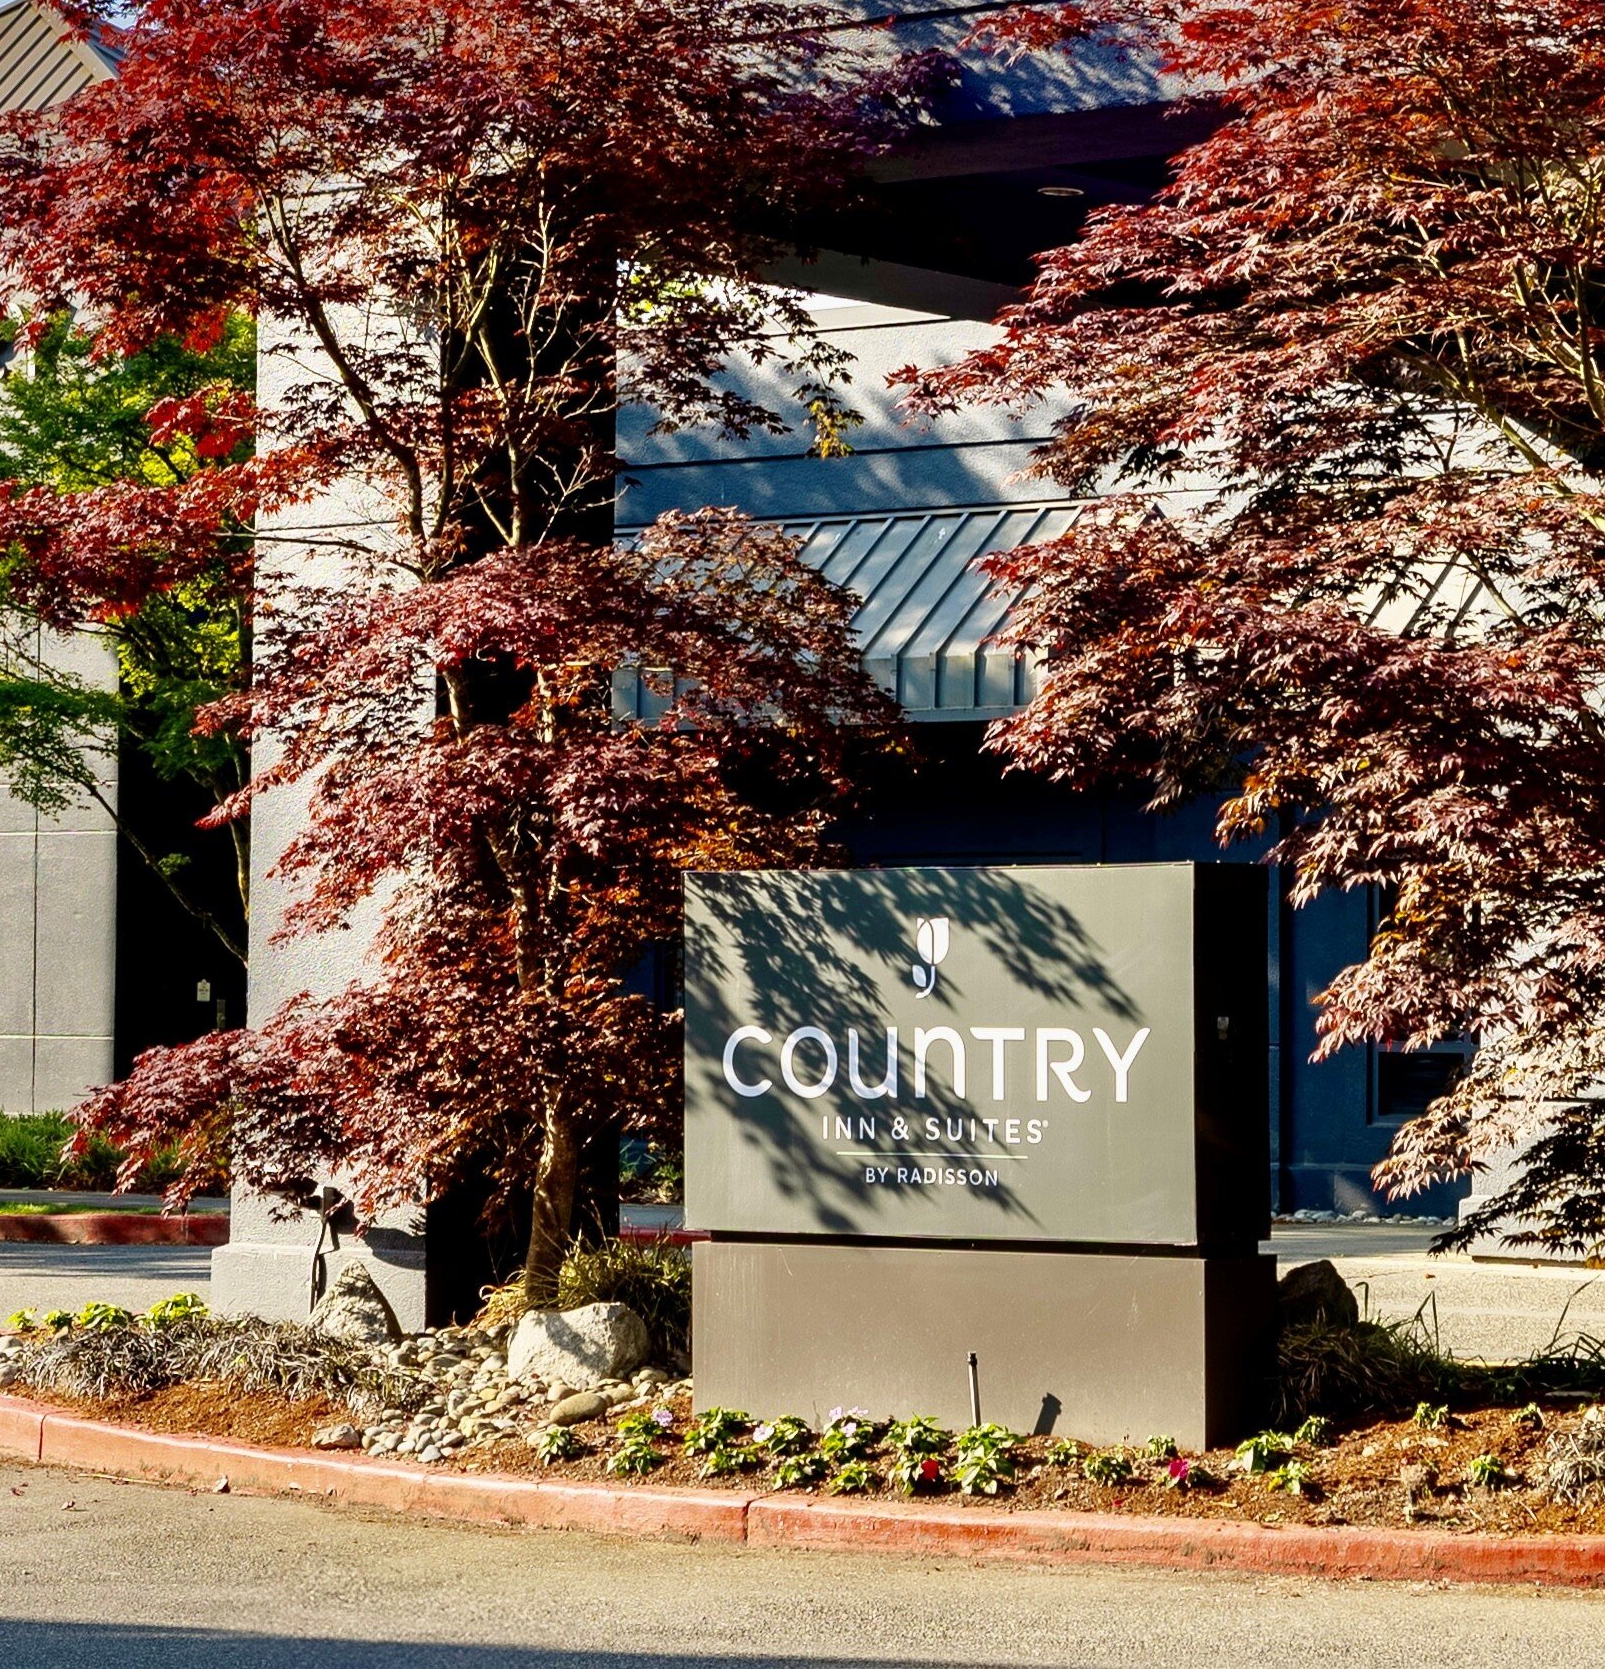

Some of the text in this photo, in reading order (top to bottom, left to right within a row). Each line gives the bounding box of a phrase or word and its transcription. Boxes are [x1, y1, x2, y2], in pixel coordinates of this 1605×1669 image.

[722, 1025, 1151, 1103] COUNTRY
[821, 1115, 1044, 1144] INN & SUITES
[865, 1166, 999, 1187] BY RADISSON
